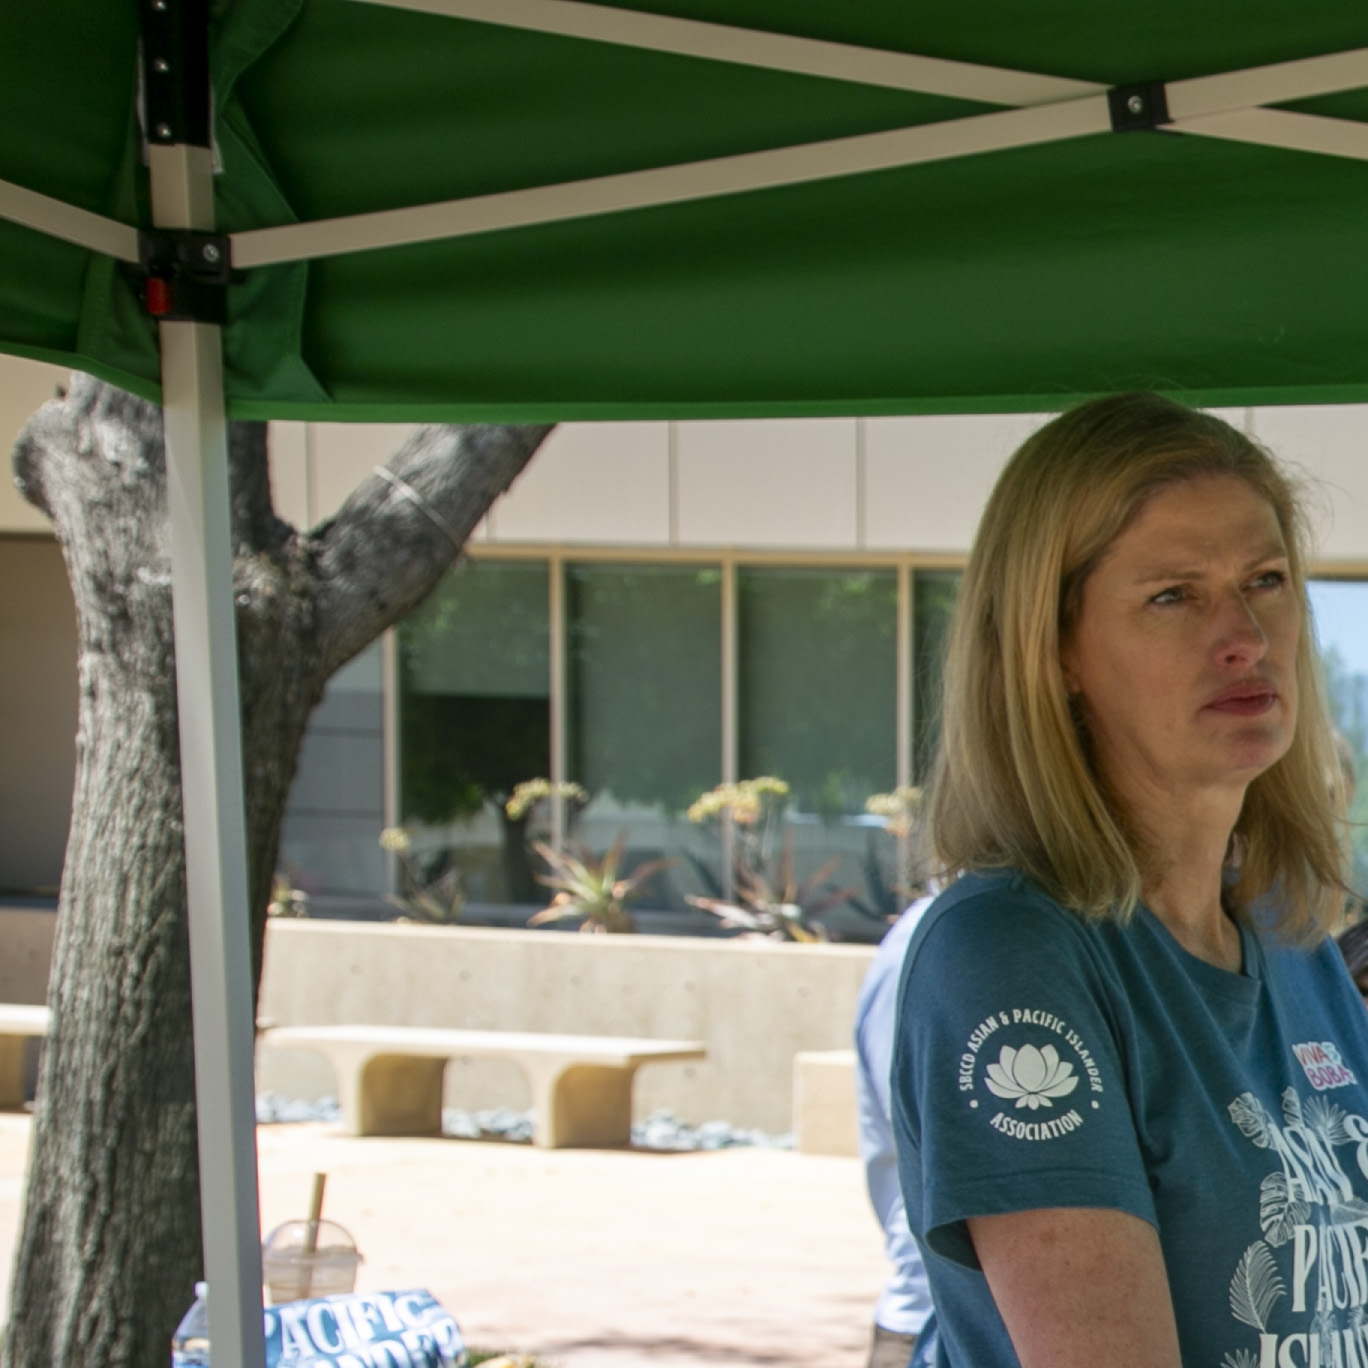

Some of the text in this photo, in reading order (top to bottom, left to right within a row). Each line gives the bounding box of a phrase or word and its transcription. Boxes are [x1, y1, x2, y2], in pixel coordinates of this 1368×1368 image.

[959, 1008, 1104, 1093] SBCCD ASIAN & PACIFIC ISLANDER
[1306, 1064, 1354, 1087] BOBA
[989, 1109, 1084, 1141] ASSOCIATION
